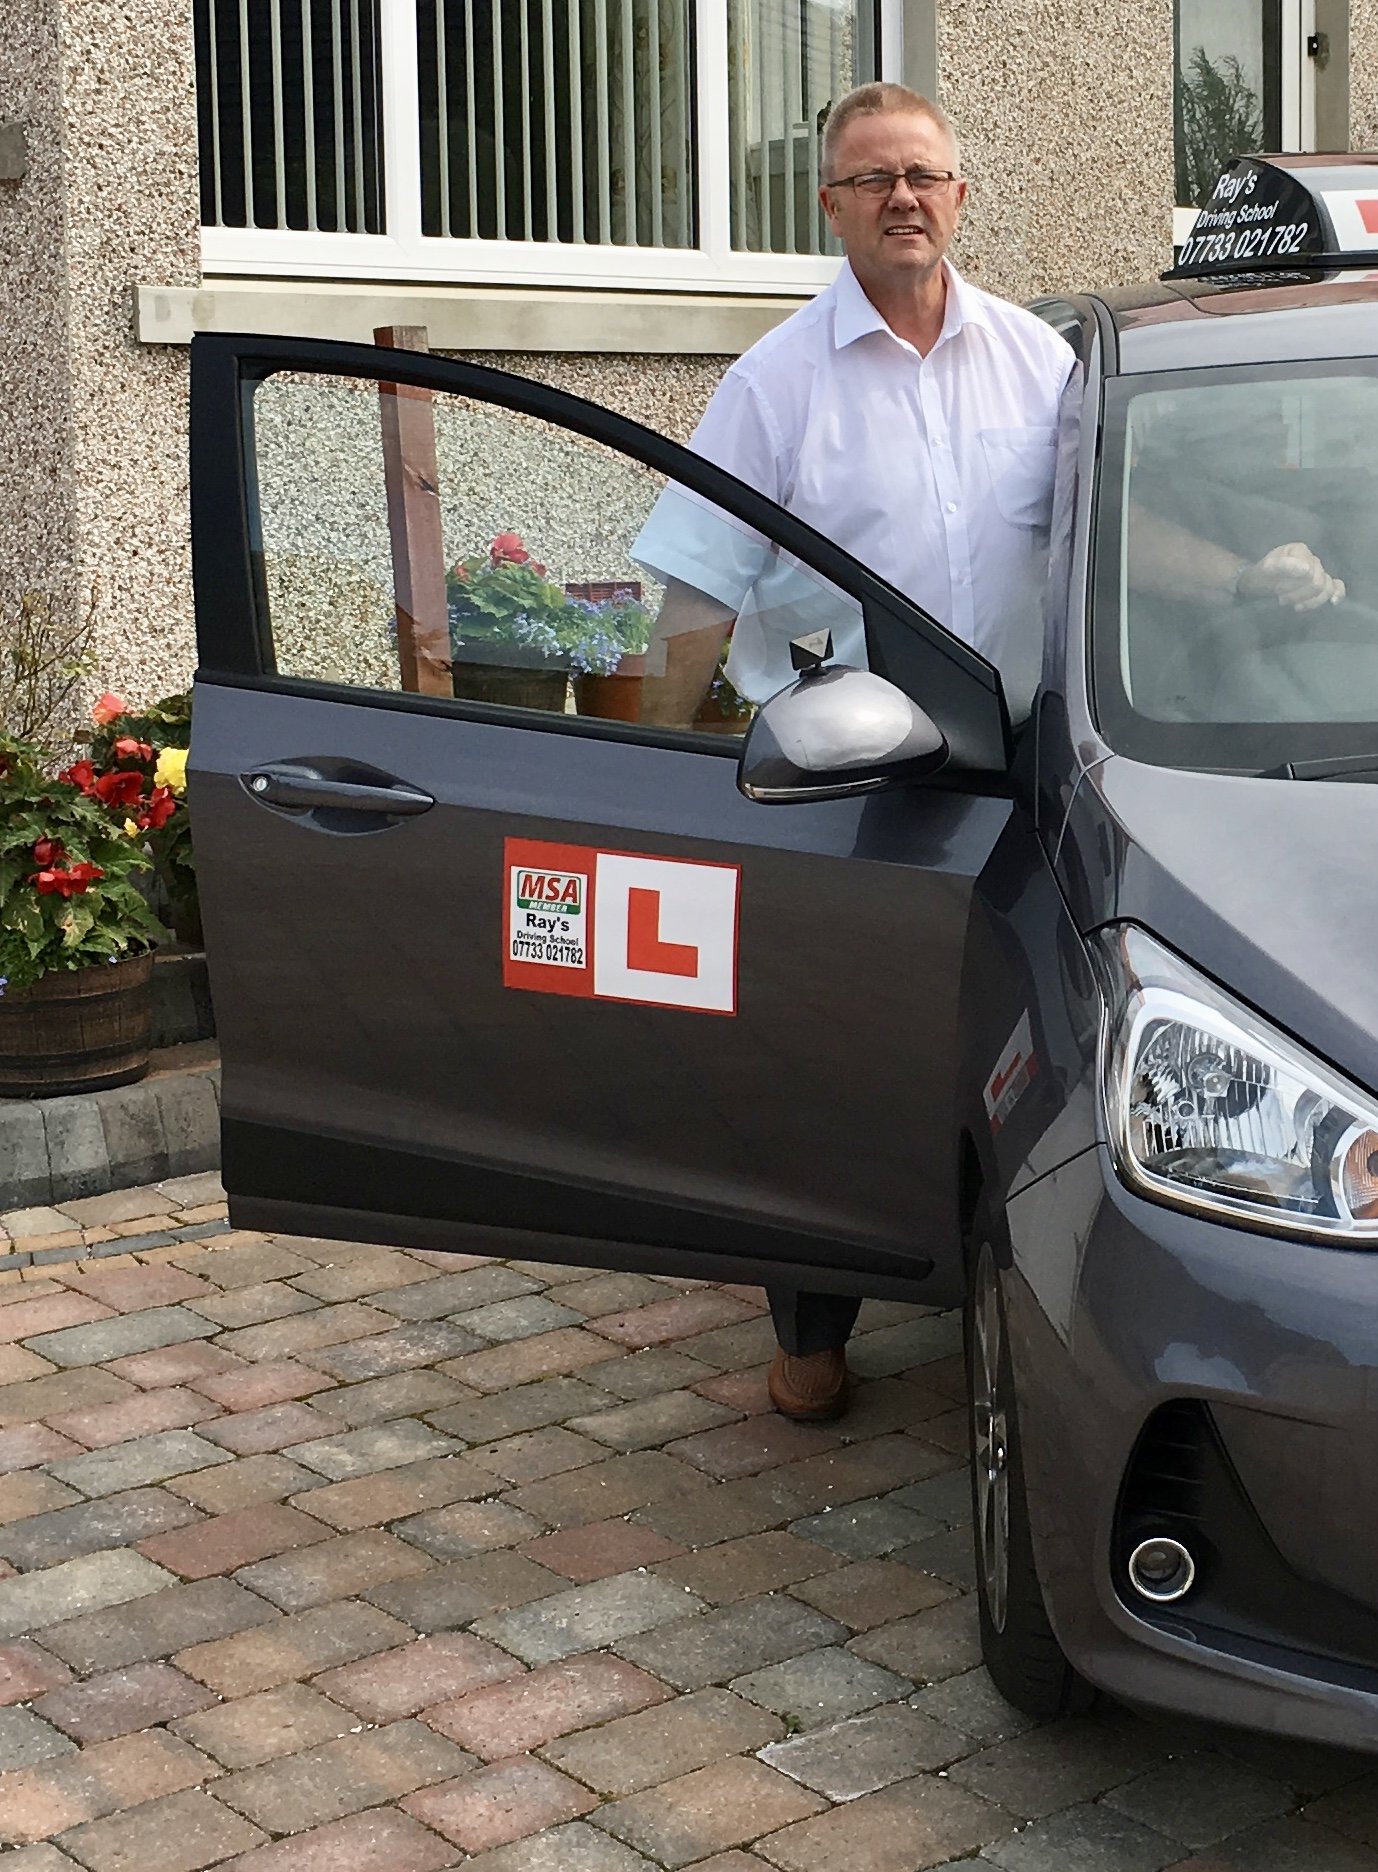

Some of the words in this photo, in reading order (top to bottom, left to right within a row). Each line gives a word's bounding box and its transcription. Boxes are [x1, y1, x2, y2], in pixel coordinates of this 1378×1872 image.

[1212, 170, 1257, 201] Ray's
[1196, 208, 1237, 230] Driving
[1236, 200, 1279, 223] School
[1178, 234, 1234, 266] 07733
[1233, 222, 1309, 259] 021782
[520, 874, 578, 904] MSA
[528, 901, 568, 913] MEMBER
[526, 912, 570, 933] Ray's
[626, 886, 699, 978] L
[512, 939, 543, 959] 07733
[546, 944, 584, 965] 021782
[517, 930, 547, 944] Driving
[549, 934, 579, 946] School
